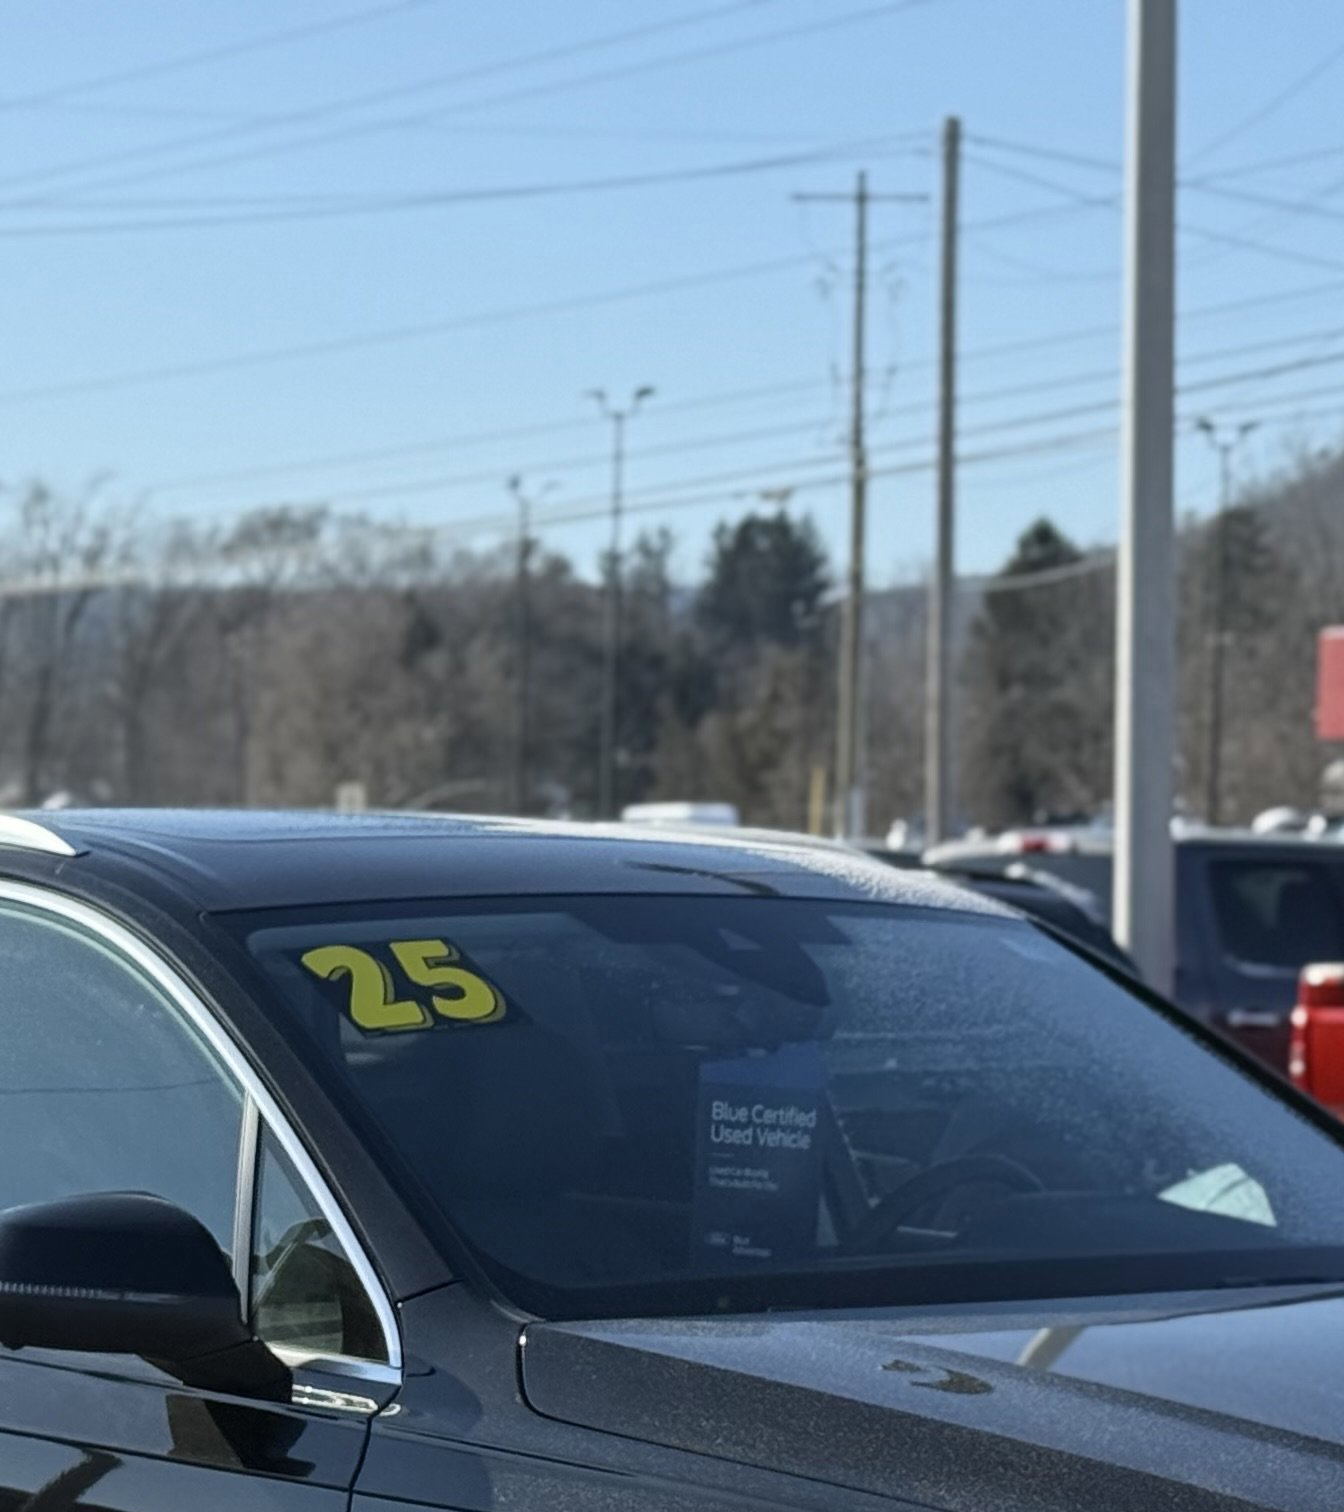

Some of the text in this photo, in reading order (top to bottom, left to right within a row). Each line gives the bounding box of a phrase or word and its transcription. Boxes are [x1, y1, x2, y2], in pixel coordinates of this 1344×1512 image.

[301, 938, 507, 1031] 25
[711, 1101, 817, 1128] Blue Certified
[710, 1124, 812, 1150] Used Vehicle
